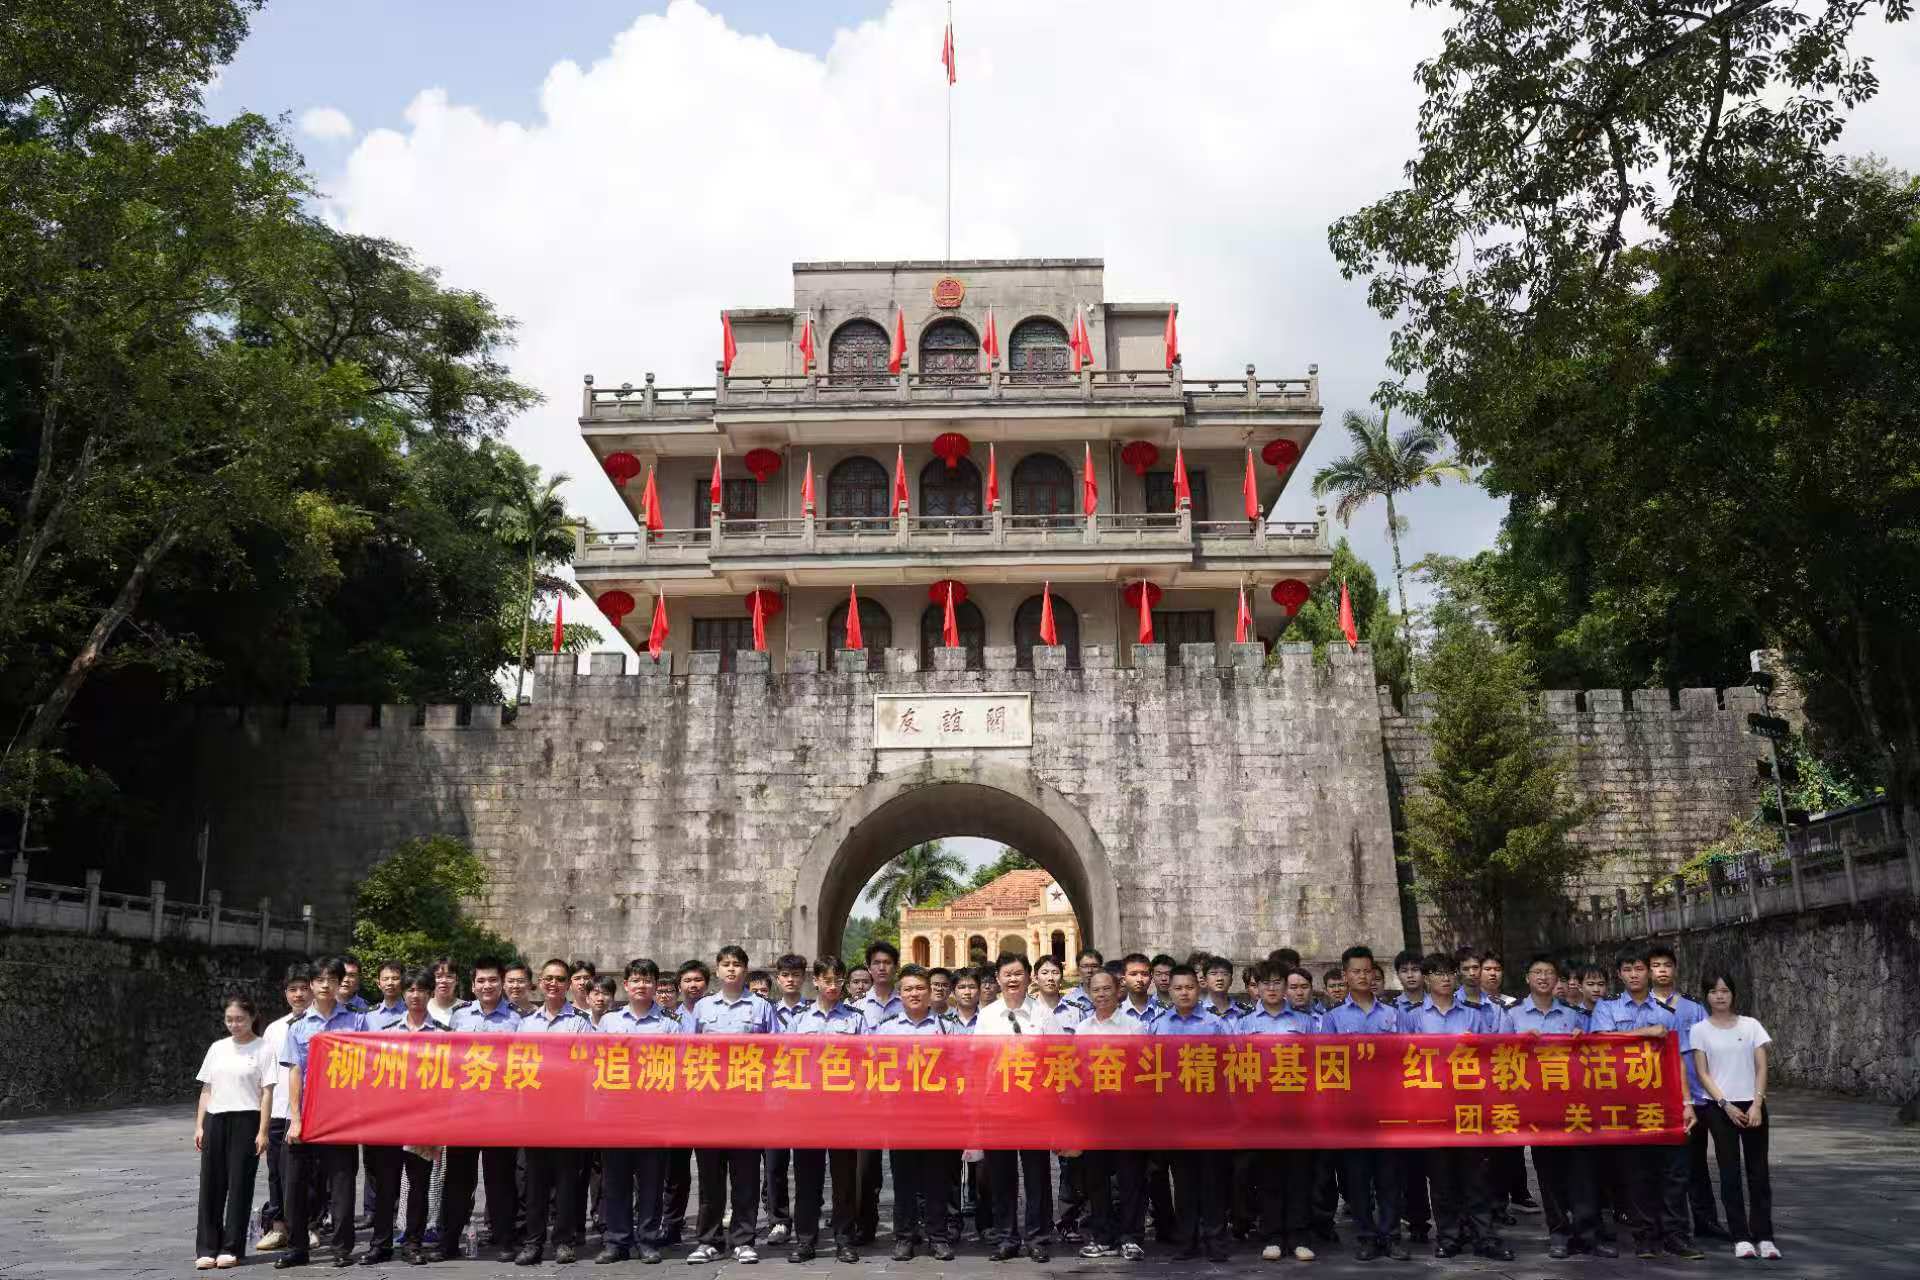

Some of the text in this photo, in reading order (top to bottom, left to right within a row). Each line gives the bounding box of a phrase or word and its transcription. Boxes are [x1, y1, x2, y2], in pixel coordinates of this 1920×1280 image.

[326, 1041, 543, 1090] 柳州机务段
[1402, 1043, 1663, 1091] 红色教育活动
